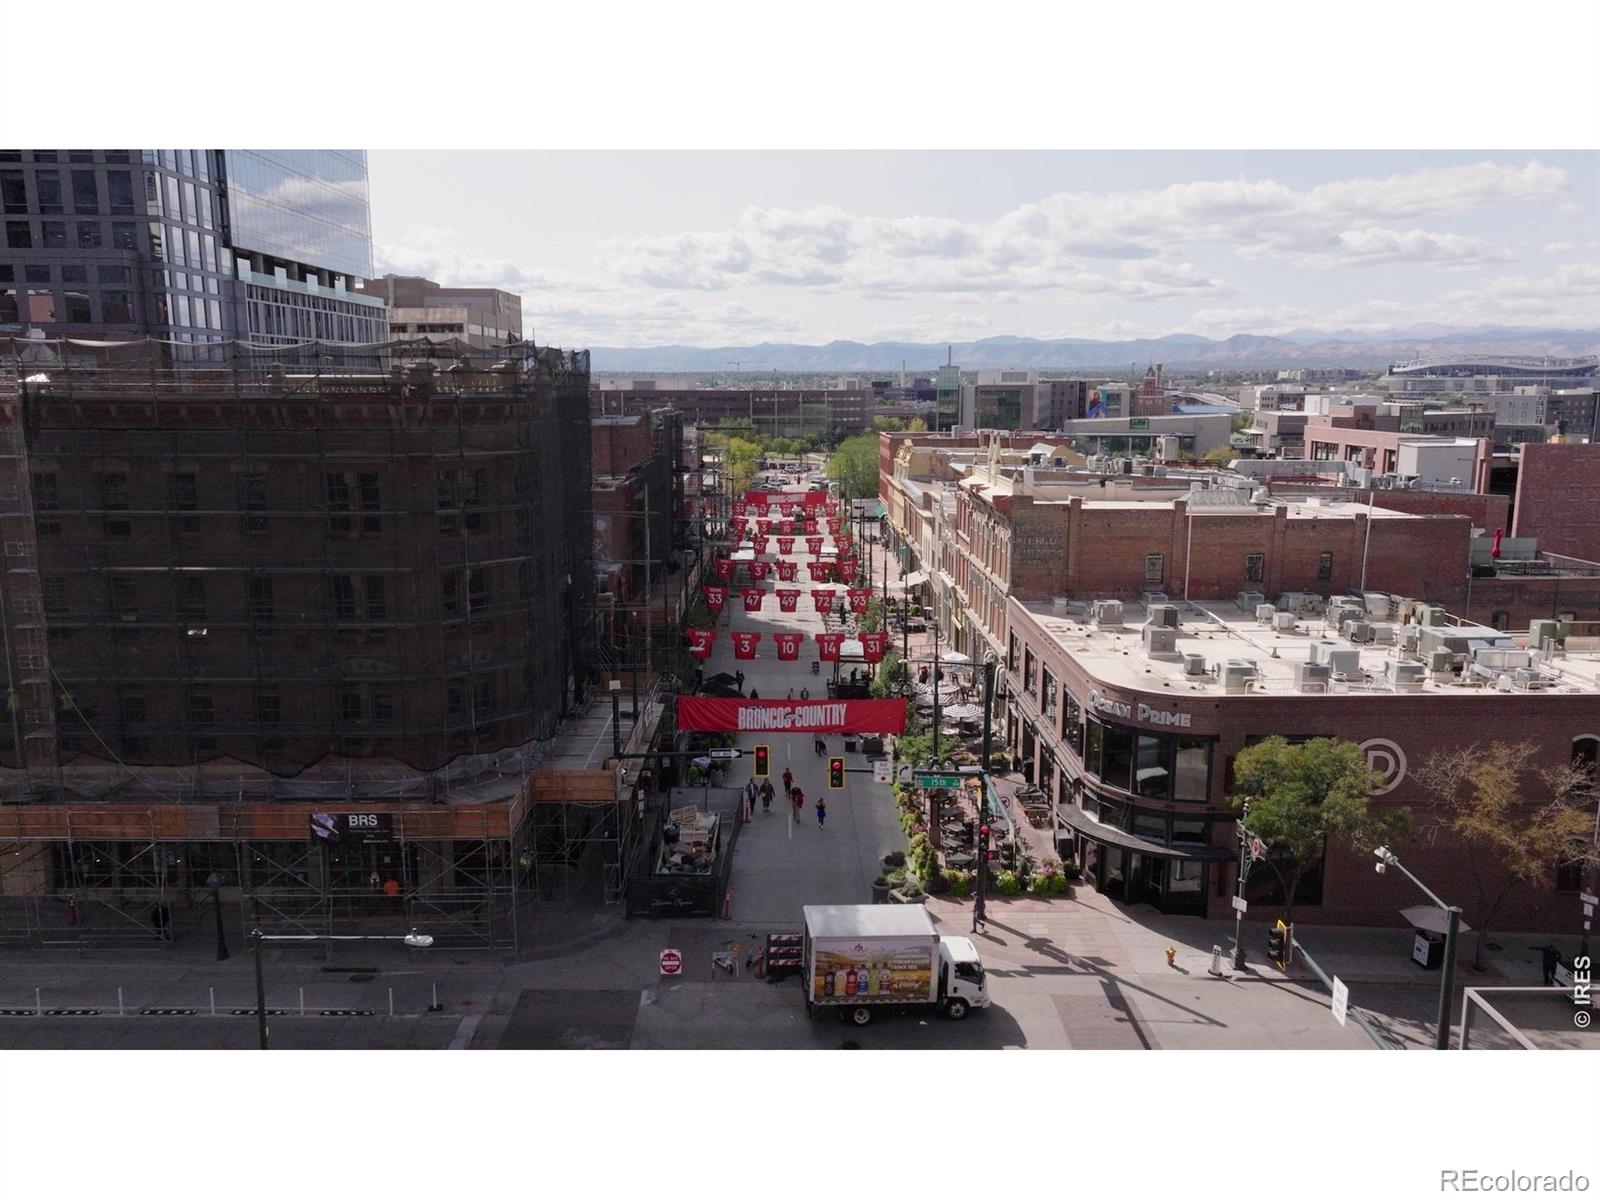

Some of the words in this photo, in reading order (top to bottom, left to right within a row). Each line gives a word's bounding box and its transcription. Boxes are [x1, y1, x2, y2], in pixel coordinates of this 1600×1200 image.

[781, 542, 791, 551] 49
[838, 541, 849, 549] 93
[721, 564, 728, 574] 2
[755, 567, 761, 576] 3
[782, 567, 791, 577] 10
[813, 567, 822, 577] 14
[844, 564, 853, 574] 31
[708, 593, 722, 604] 33
[746, 594, 759, 606] 47
[781, 595, 795, 607] 49
[817, 595, 830, 607] 72
[852, 595, 866, 606] 93
[698, 638, 706, 650] 2
[741, 640, 750, 653] 3
[782, 641, 795, 654] 10
[823, 642, 836, 654] 14
[867, 640, 880, 653] 31
[738, 706, 792, 730] BRONCOS
[794, 703, 847, 728] COUNTRY
[1138, 703, 1191, 727] PRIME
[931, 778, 947, 787] 15th
[348, 815, 378, 826] BRS
